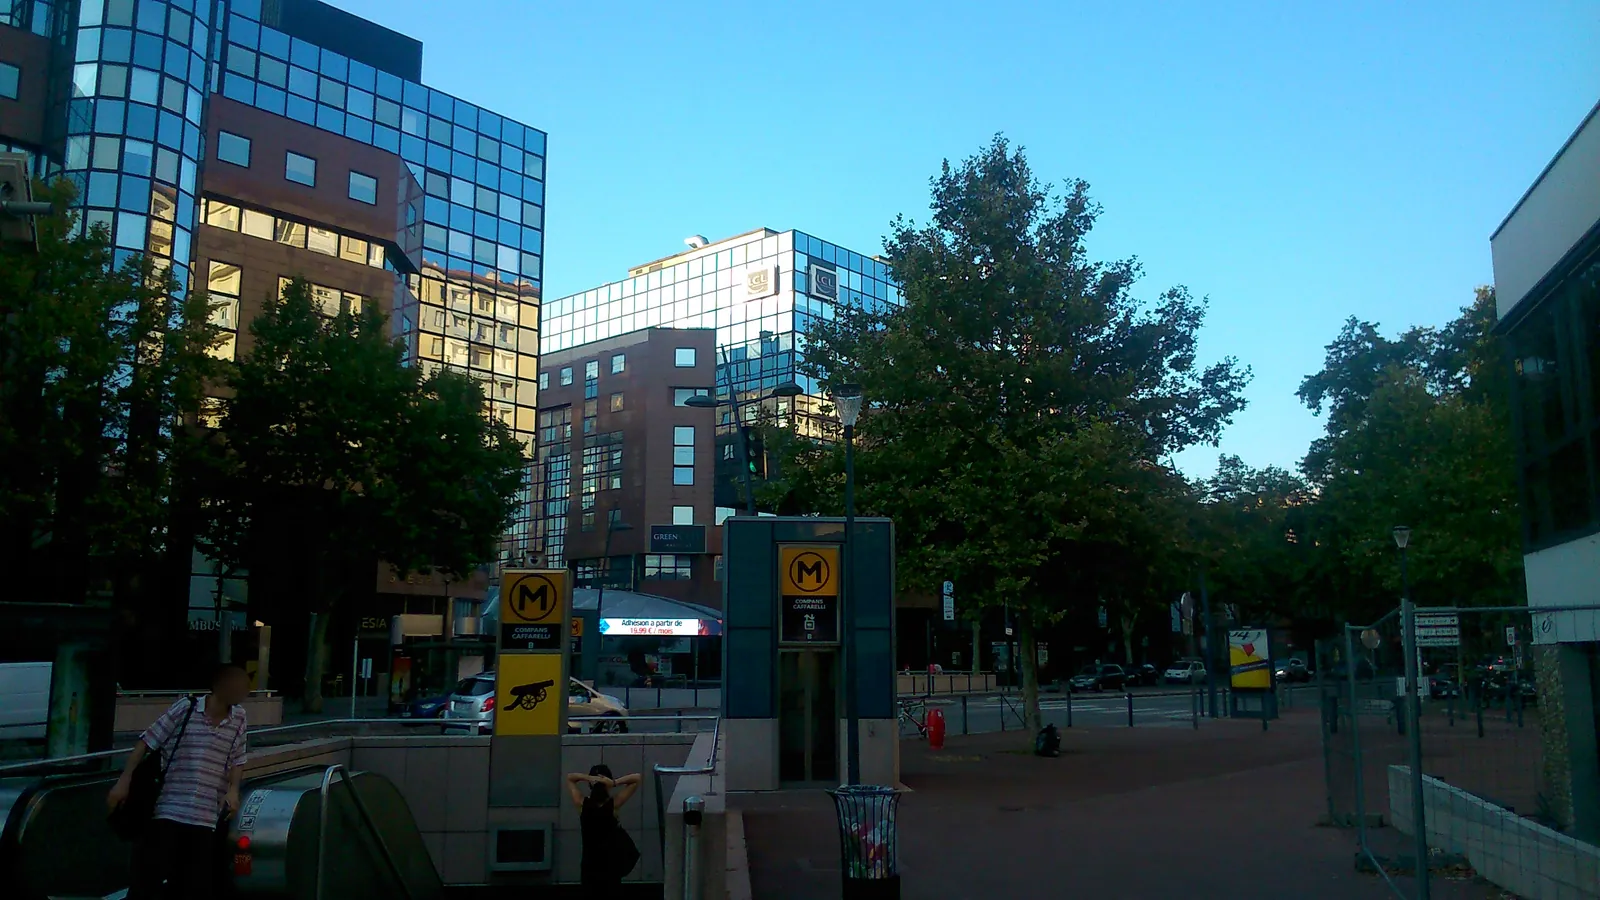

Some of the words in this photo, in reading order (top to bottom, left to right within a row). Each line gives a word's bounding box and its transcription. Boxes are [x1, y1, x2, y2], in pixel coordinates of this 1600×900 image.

[747, 274, 768, 287] LCL
[816, 273, 834, 287] LCL
[653, 533, 678, 541] GREEN
[798, 560, 822, 584] M
[518, 584, 548, 611] M
[674, 619, 684, 627] de
